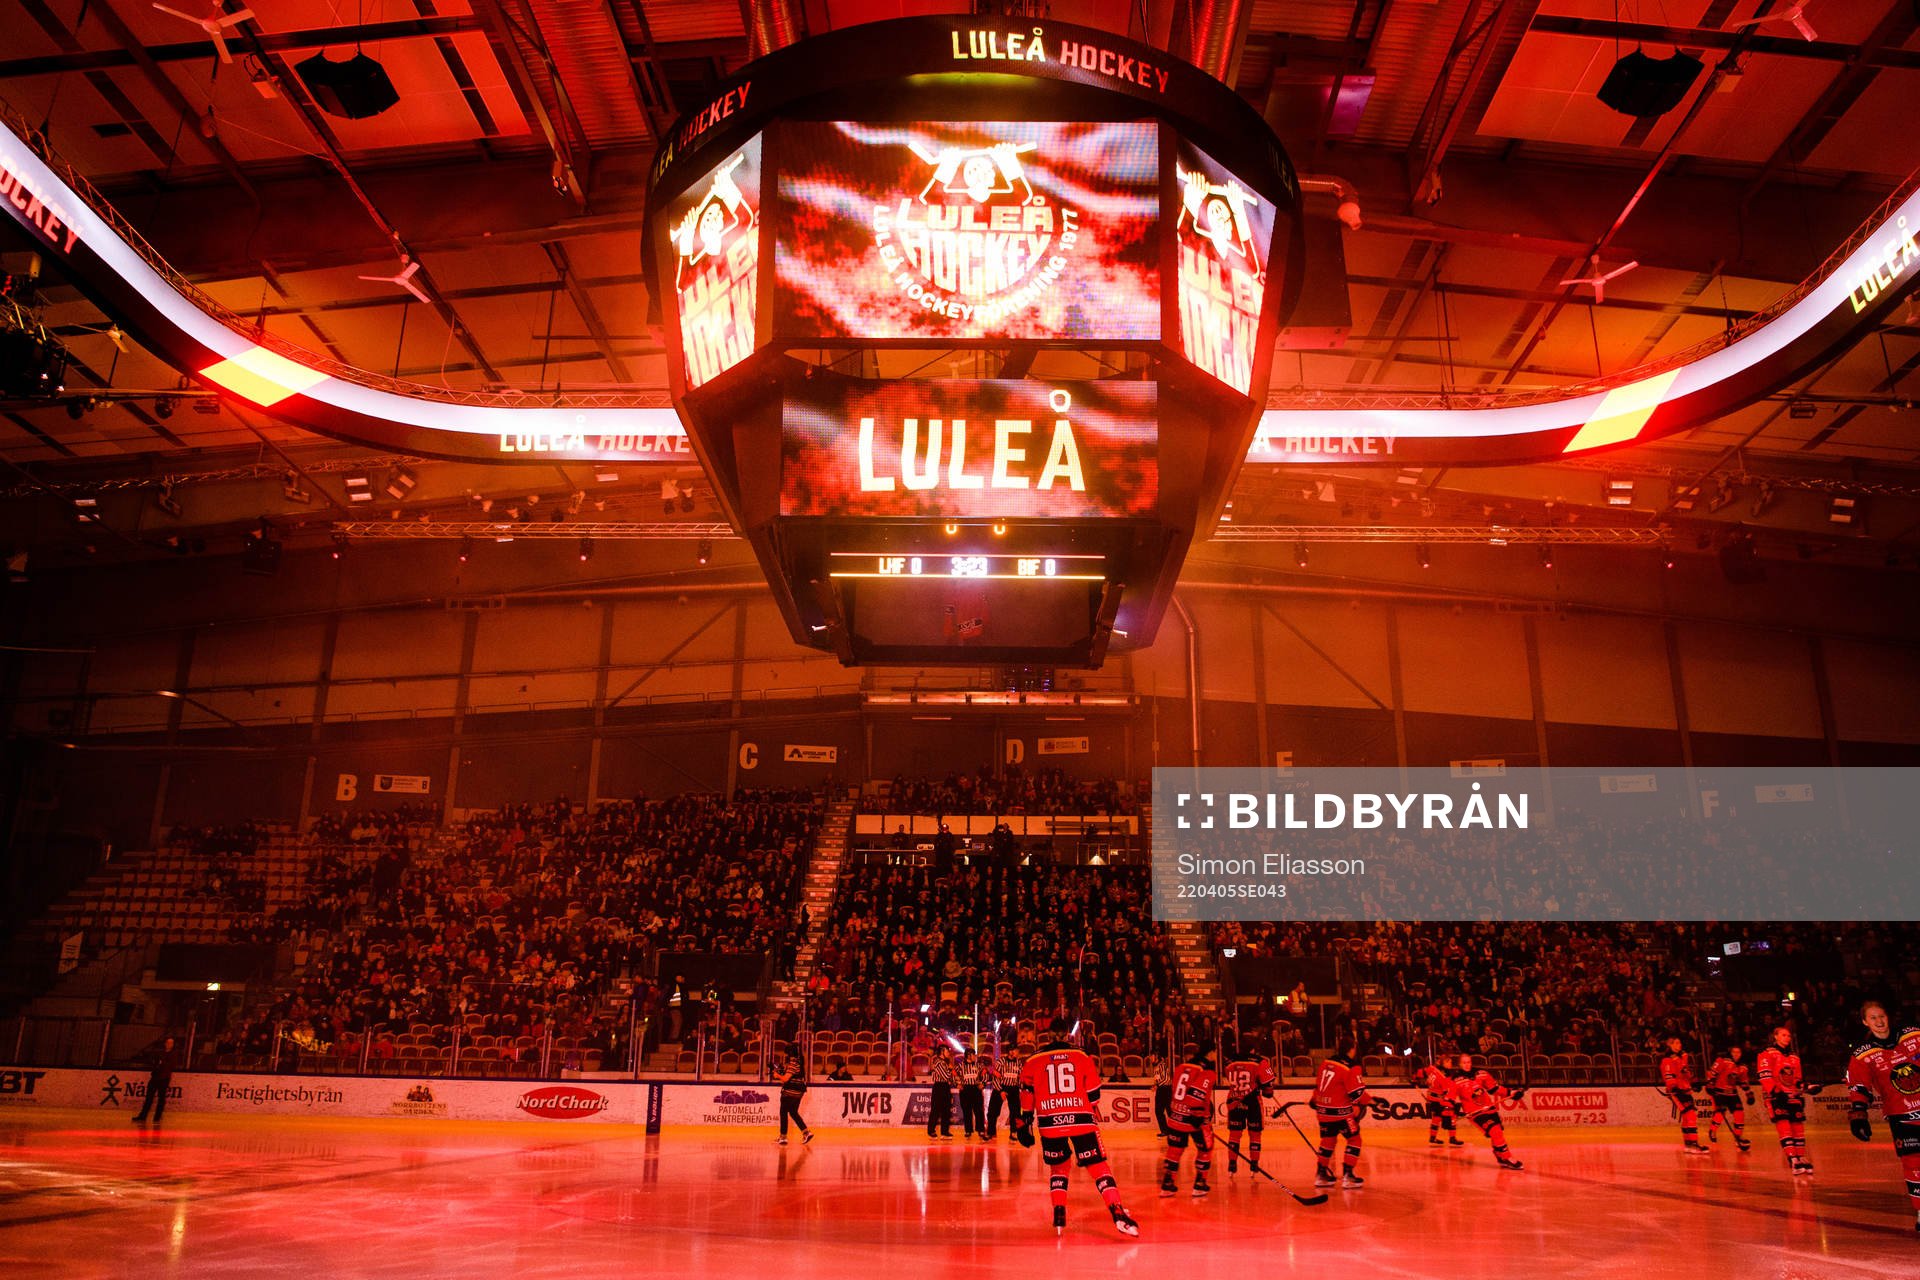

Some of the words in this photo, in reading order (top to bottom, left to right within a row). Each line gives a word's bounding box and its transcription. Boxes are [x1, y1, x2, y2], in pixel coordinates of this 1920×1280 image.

[951, 27, 1046, 62] LULEÅ
[1060, 40, 1169, 93] HOCKEY
[678, 81, 751, 152] HOCKEY
[0, 156, 84, 255] OCKEY
[896, 195, 1054, 232] LULEÅ
[1058, 207, 1080, 251] 1977
[900, 230, 1052, 297] HOCKEY
[1845, 215, 1920, 314] LULEÅ
[500, 414, 586, 452] LULEÅ
[598, 427, 690, 453] HOCKE
[858, 389, 1086, 492] LULEÅ
[1284, 427, 1399, 455] HOCKEY
[740, 743, 758, 769] C
[1006, 739, 1024, 764] D
[1276, 752, 1294, 777] E
[336, 774, 357, 801] B
[1701, 790, 1719, 817] F
[123, 1081, 183, 1098] Nåen
[1046, 1062, 1077, 1094] 16
[1174, 1073, 1190, 1101] 6
[1319, 1069, 1336, 1093] 17
[216, 1082, 343, 1106] Fastighetsbyrån
[841, 1092, 892, 1118] JWAB
[1041, 1096, 1084, 1111] NIEMINEN
[1535, 1095, 1605, 1107] KVANTUM
[703, 1114, 772, 1124] TAKENTREPRENAD
[718, 1105, 764, 1115] PATOMELLA
[1052, 1115, 1075, 1125] SSAB
[1371, 1097, 1467, 1120] SCAA
